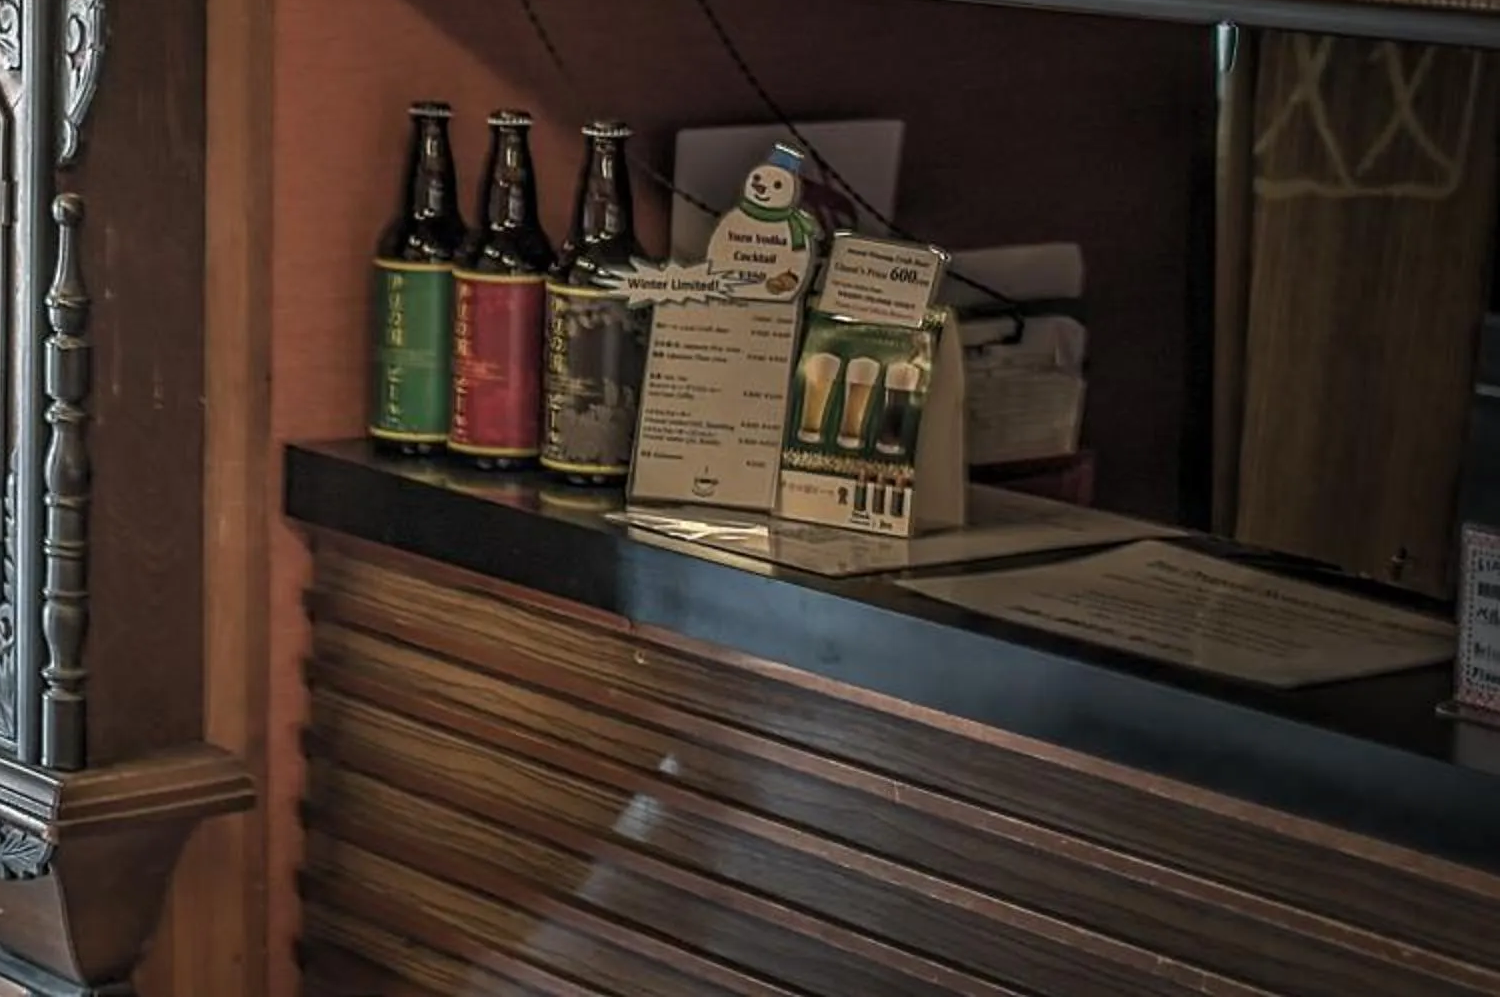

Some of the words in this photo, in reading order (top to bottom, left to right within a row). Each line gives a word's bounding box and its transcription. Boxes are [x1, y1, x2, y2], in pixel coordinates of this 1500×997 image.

[733, 250, 777, 264] Cocktail
[627, 278, 668, 291] Winter
[671, 279, 720, 292] Limited!
